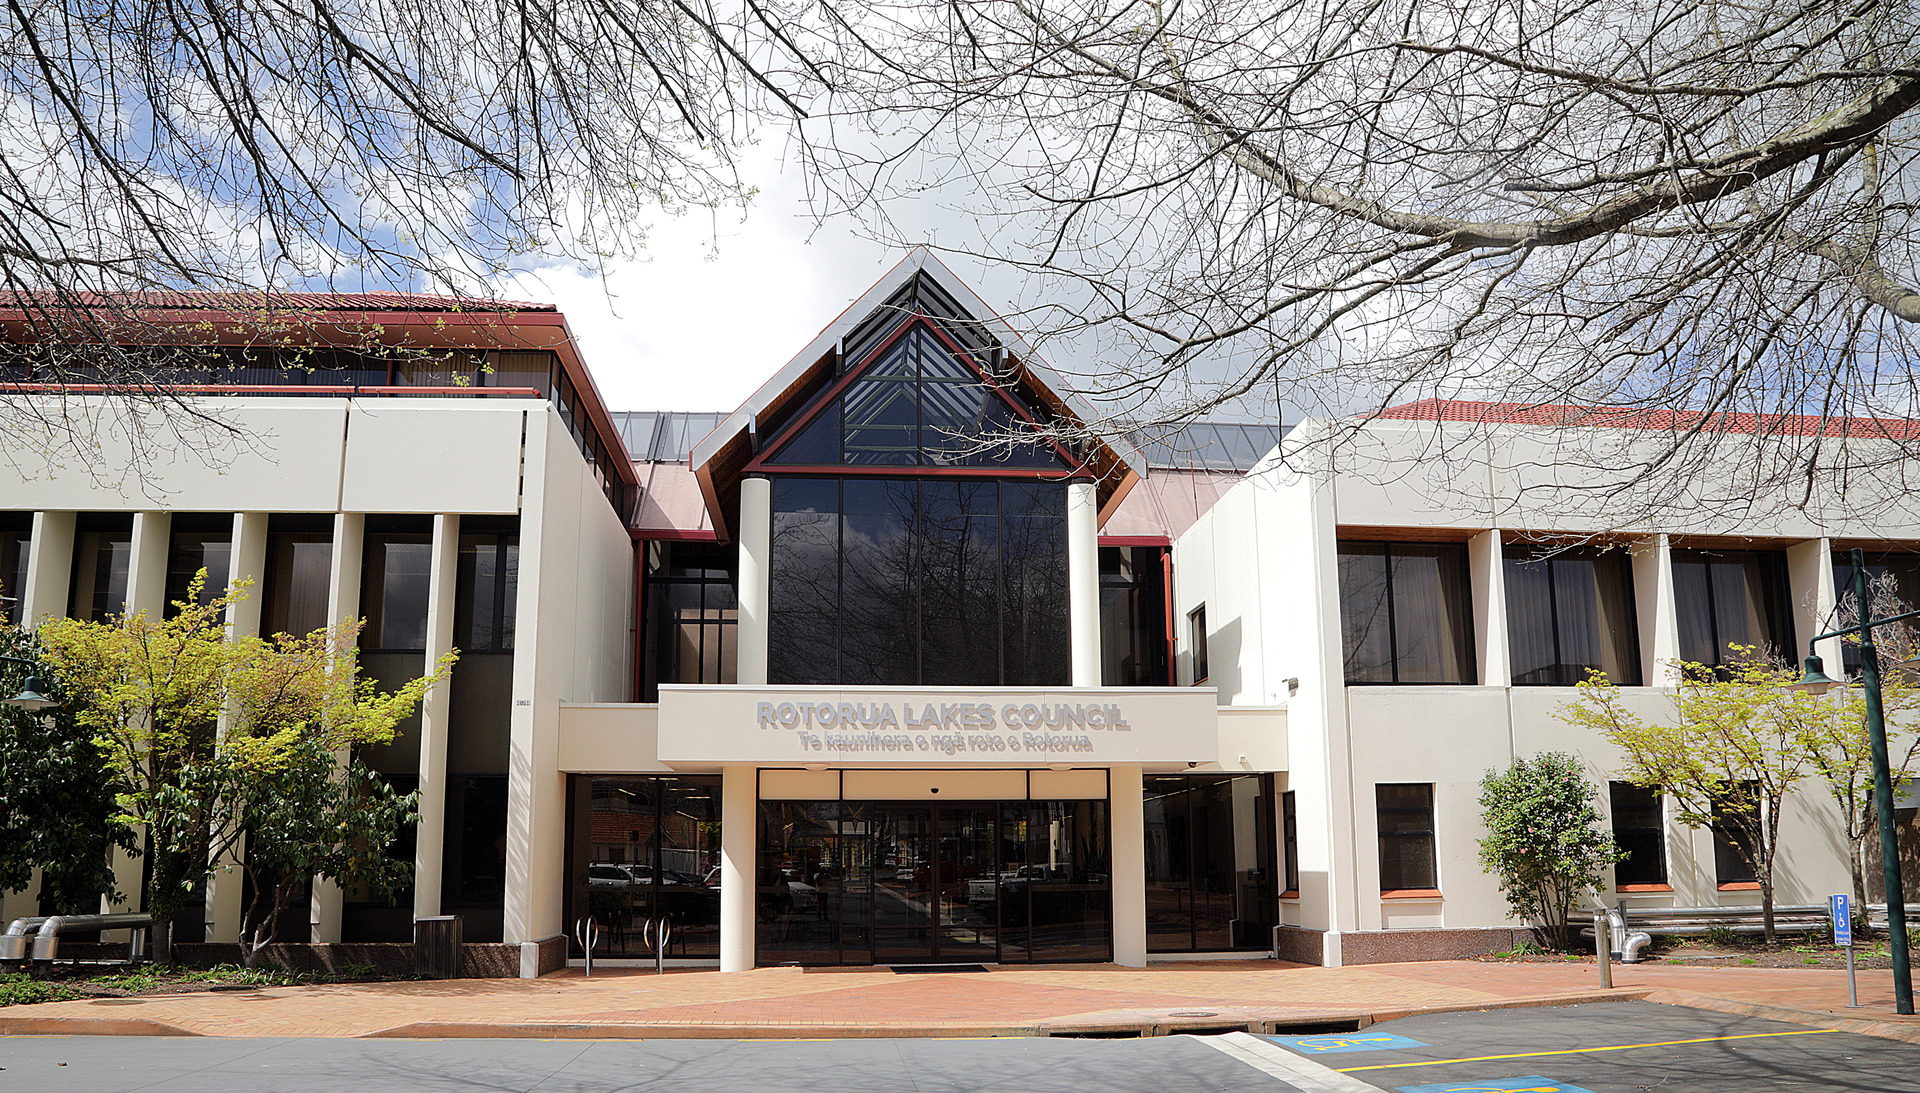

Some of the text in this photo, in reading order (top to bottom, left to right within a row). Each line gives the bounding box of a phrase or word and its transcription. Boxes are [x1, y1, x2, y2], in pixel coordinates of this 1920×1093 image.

[757, 702, 1127, 725] ROTORUA LAKES COUNCIL
[797, 731, 819, 746] Te
[824, 731, 910, 746] kaunihera
[915, 734, 926, 746] o
[968, 733, 1005, 746] roto
[1007, 735, 1018, 747] o
[1023, 732, 1089, 747] Rotorua
[1837, 896, 1844, 910] P
